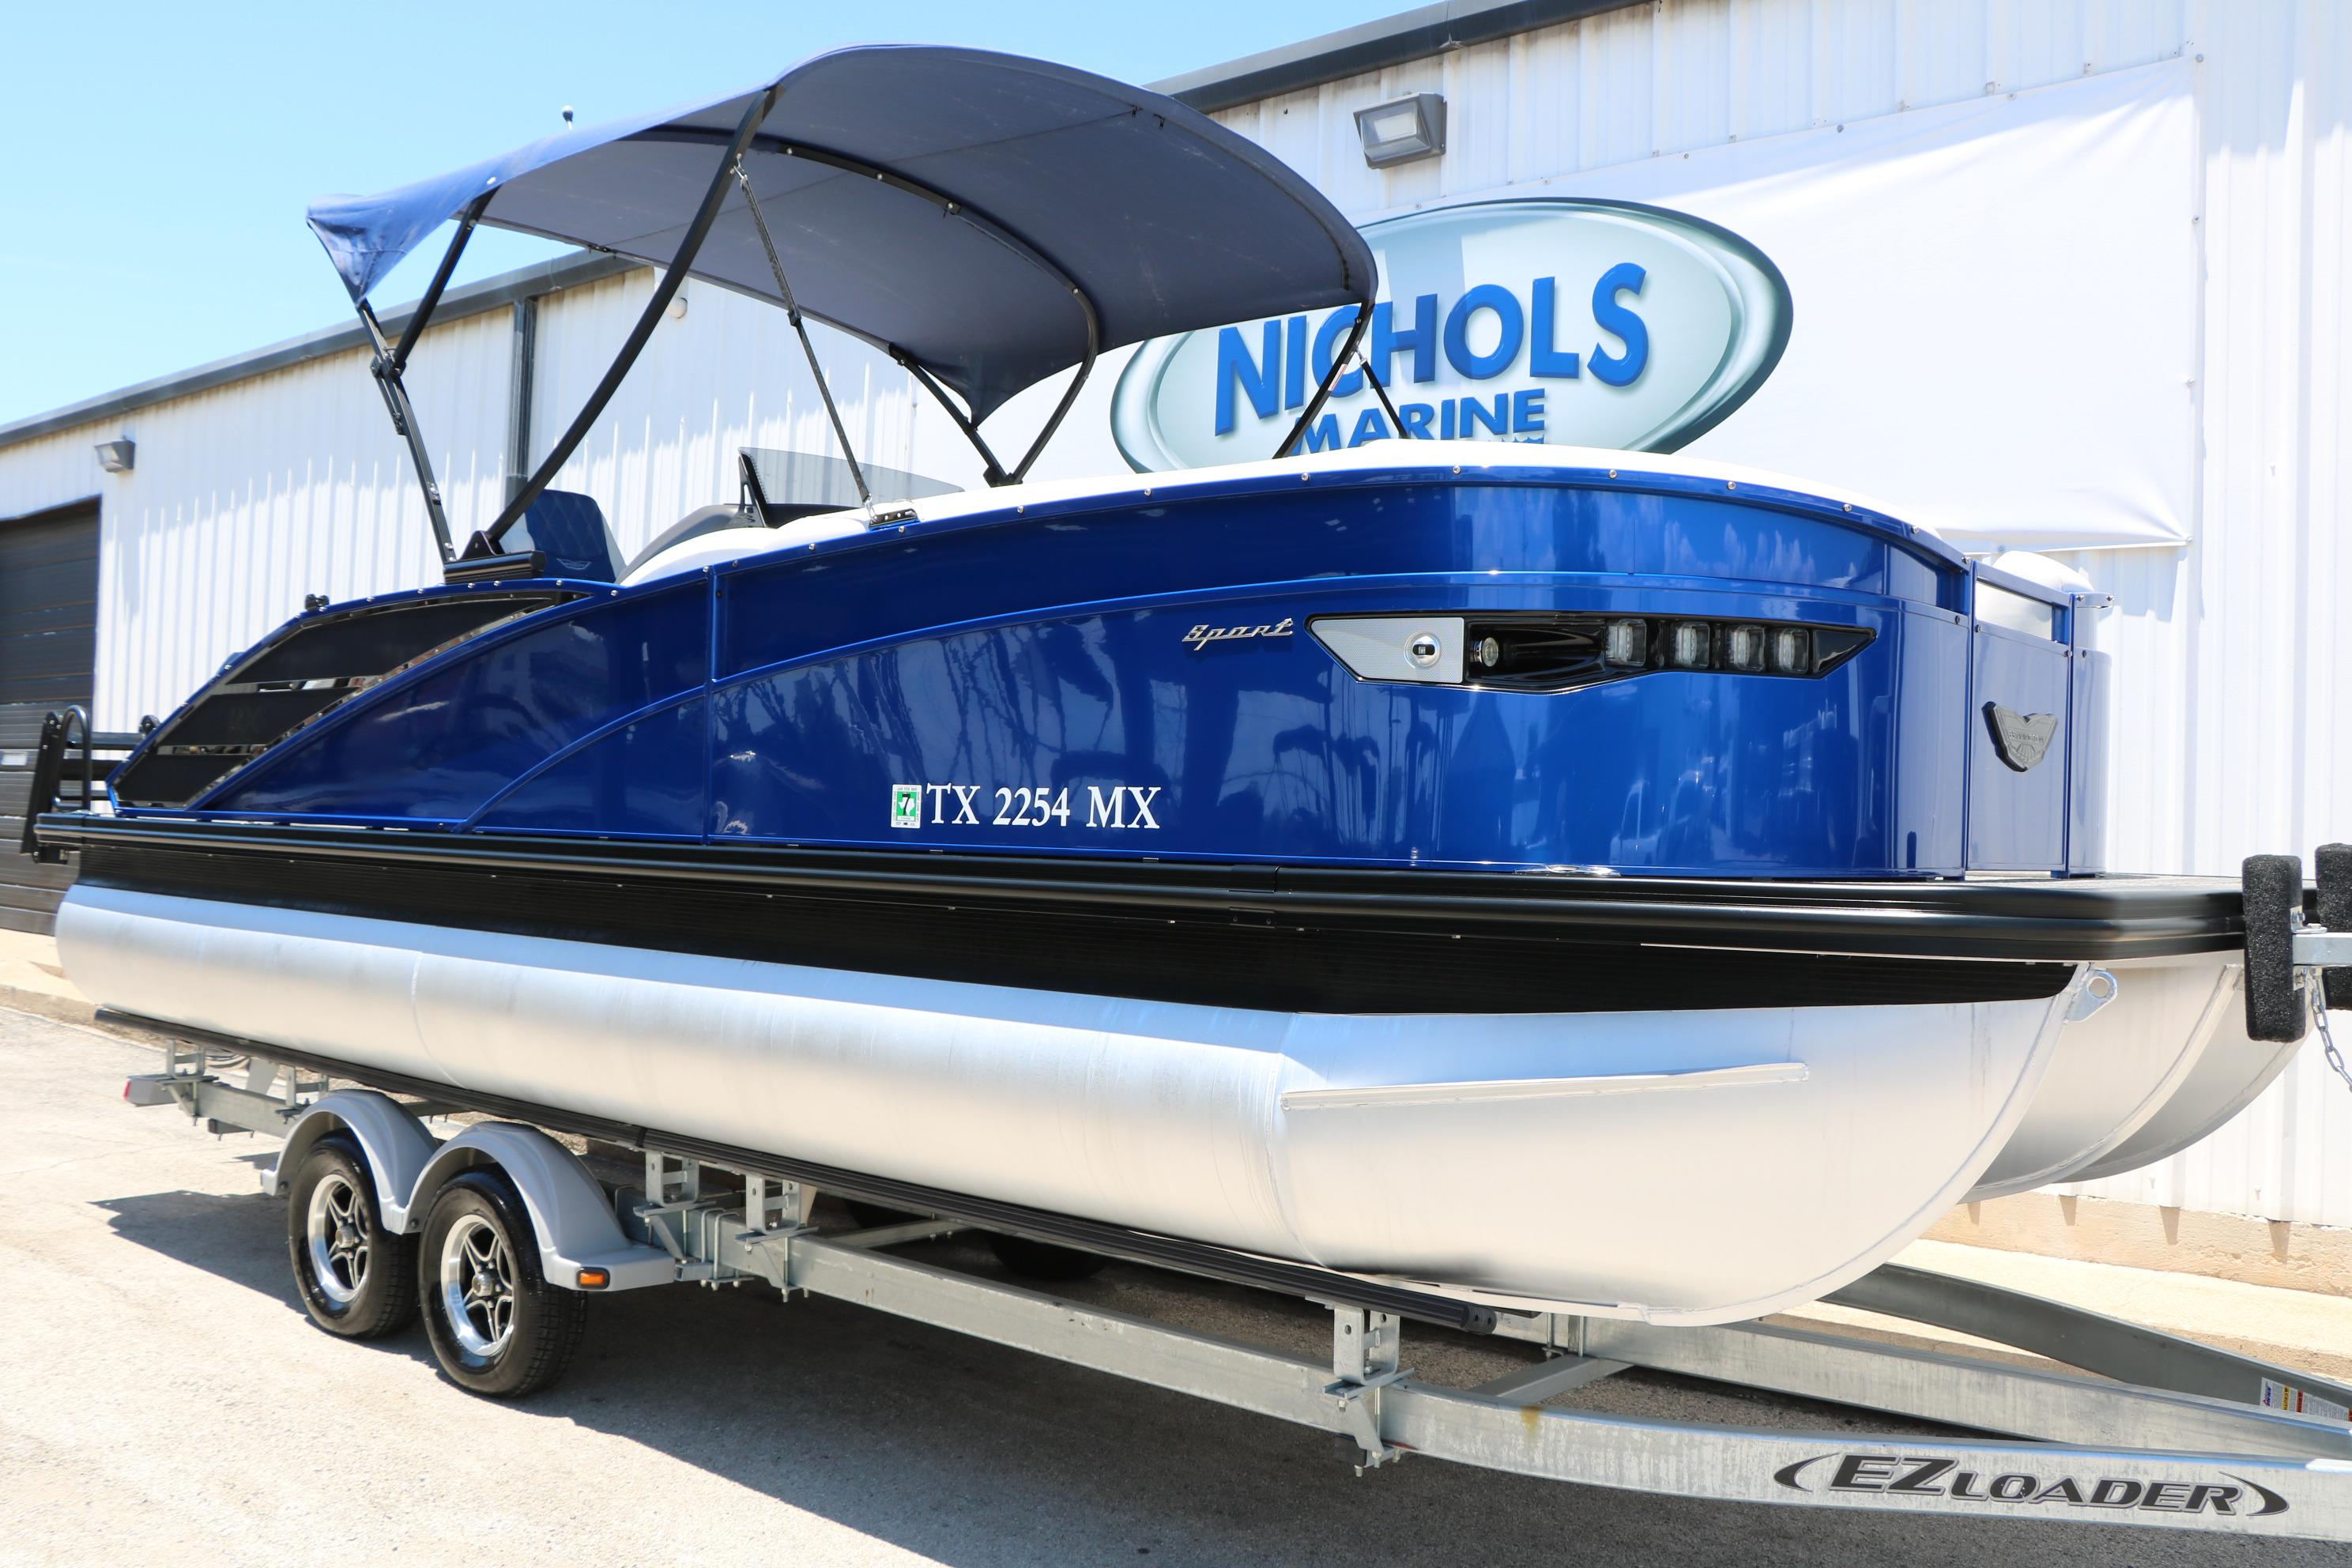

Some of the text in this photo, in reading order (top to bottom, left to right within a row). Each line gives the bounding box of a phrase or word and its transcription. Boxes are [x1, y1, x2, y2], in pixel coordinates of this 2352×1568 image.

[1215, 262, 1649, 436] NICHOLS
[1290, 388, 1545, 456] MARINE
[1182, 617, 1293, 650] Sport
[902, 793, 911, 816] 7
[926, 782, 981, 824] TX
[993, 787, 1070, 827] 2254
[1086, 786, 1162, 829] MX
